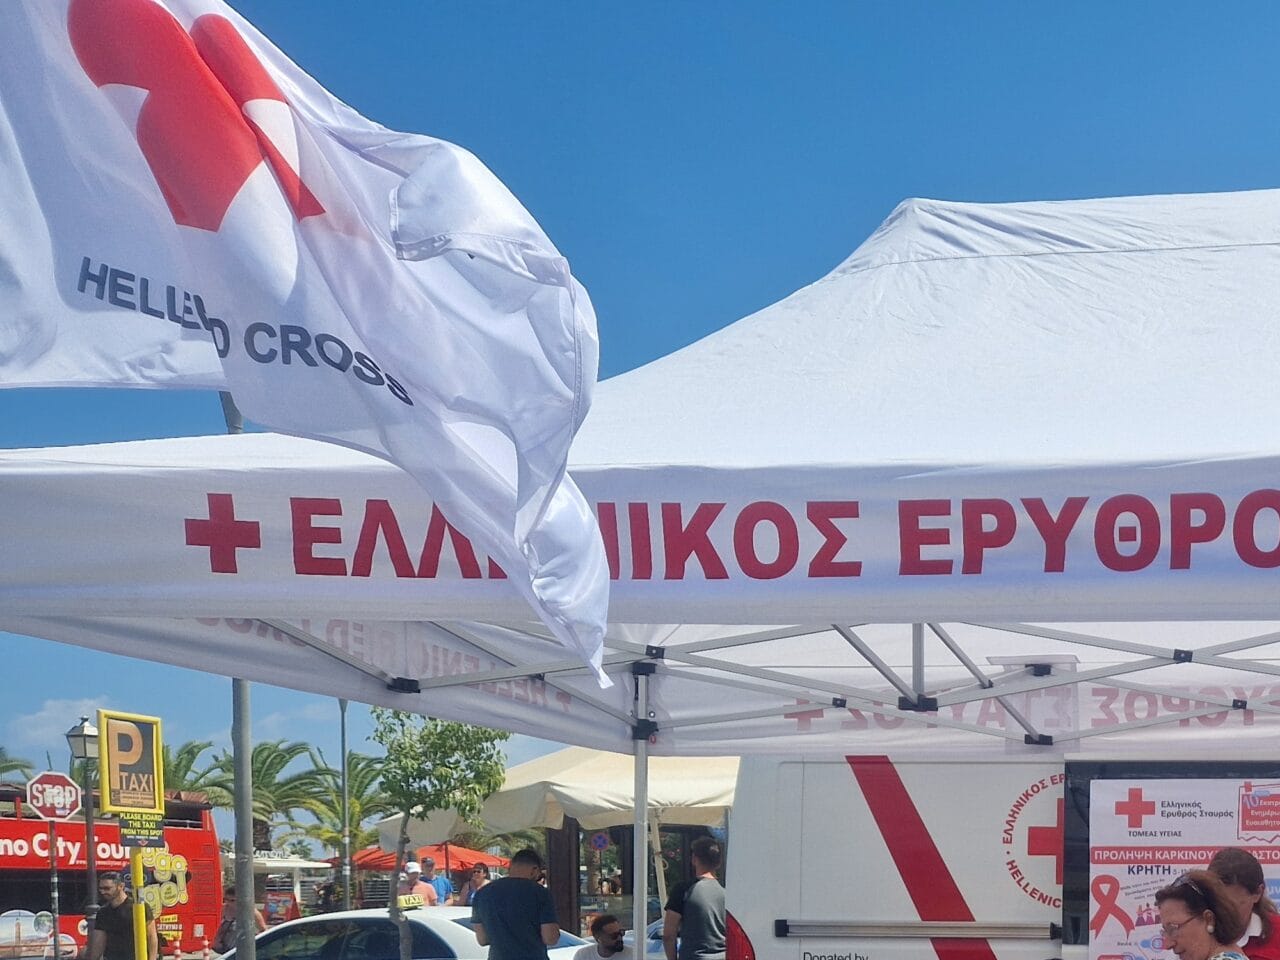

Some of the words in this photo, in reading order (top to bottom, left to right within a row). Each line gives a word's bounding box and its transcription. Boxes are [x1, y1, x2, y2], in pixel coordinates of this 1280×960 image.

[243, 321, 414, 407] CROSS
[289, 497, 863, 580] ΕΛΛΙΚΟΣ
[107, 720, 143, 789] P
[120, 771, 154, 791] TAXI
[32, 784, 76, 808] STOP
[1002, 778, 1049, 845] ΕΛΛΗΝΙΚΟΣ
[1160, 801, 1202, 811] Ελληνικός
[120, 813, 141, 821] PLEASE
[142, 813, 162, 822] BOARD
[1160, 809, 1197, 819] Ερυθρός
[1199, 809, 1234, 818] Σταυρός
[121, 828, 136, 836] FROM
[128, 820, 141, 828] THE
[142, 821, 156, 829] TAXI
[1128, 830, 1158, 838] ΤΟΜΕΑΣ
[32, 833, 81, 865] Cty
[1094, 850, 1152, 861] ΠΡΟΛΗΨΗ
[1155, 850, 1213, 861] ΚΑΡΚΙΝΟΥ
[1127, 865, 1171, 875] ΚΡΗΤΗ
[1006, 860, 1062, 908] HELLENIC
